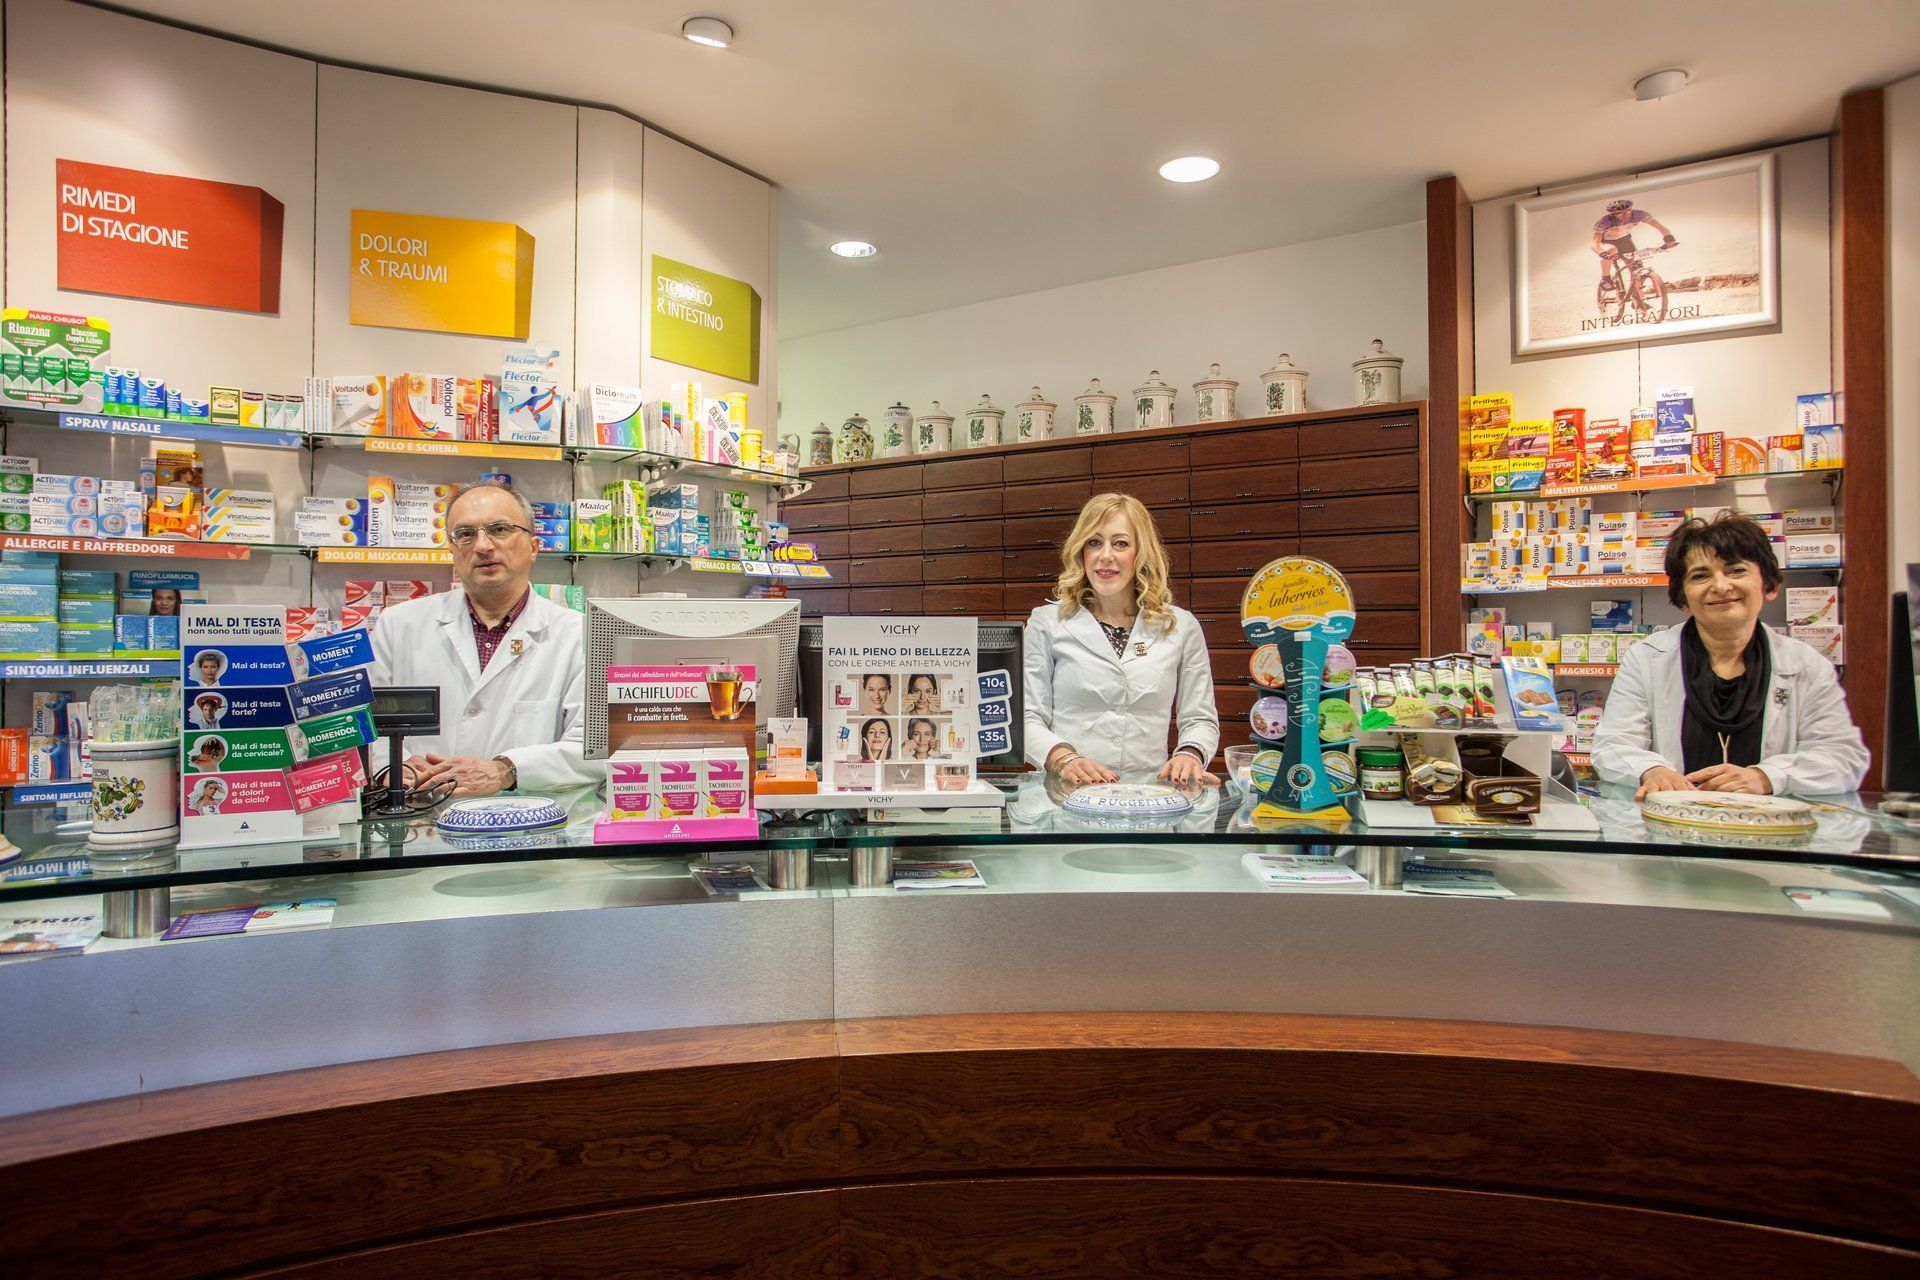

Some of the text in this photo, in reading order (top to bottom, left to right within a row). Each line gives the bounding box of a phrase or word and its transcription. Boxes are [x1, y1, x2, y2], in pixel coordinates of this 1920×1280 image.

[62, 184, 136, 215] RIMEDI
[62, 212, 189, 250] DI STAGIONE
[360, 233, 428, 256] DOLORI
[359, 258, 448, 283] & TRAUMI
[657, 276, 713, 307] STOMACO
[29, 313, 87, 325] NASO CHIUSO?
[657, 298, 724, 331] & INTESTINO
[1581, 304, 1701, 331] INTEGRATORI
[8, 322, 51, 337] Rinazina
[505, 354, 537, 365] Flector
[504, 370, 541, 383] Flector
[335, 385, 365, 394] Voltadol
[595, 387, 637, 400] Dicloreum
[444, 377, 454, 417] Voltadol
[65, 416, 161, 434] SPRAY NASALE
[1511, 425, 1544, 433] Friliver
[511, 432, 540, 442] Flector
[371, 440, 458, 454] COLLO E SCHIENA
[1713, 433, 1722, 469] SUSTENIUM
[397, 483, 429, 493] Voltaren
[1545, 484, 1617, 496] MULTIVITAMINICI
[228, 495, 272, 503] VEGETALLUMINA
[305, 497, 334, 506] Voltaren
[395, 499, 428, 508] Voltaren
[580, 502, 609, 511] Maalox
[298, 513, 327, 521] Voltaren
[394, 515, 428, 524] Voltaren
[655, 510, 677, 519] Maalox
[1599, 521, 1627, 529] Polase
[1786, 516, 1816, 524] Polase
[370, 507, 379, 546] Voltaren
[302, 531, 331, 539] Voltaren
[392, 530, 426, 539] Voltaren
[4, 538, 175, 554] ALLERGIE E RAFFREDDORE
[324, 551, 437, 562] DOLORI MUSCOLARI E
[695, 560, 731, 570] STOMACO E
[132, 572, 196, 580] RINOFLUIMUCIL
[1606, 577, 1649, 586] POTASSIO
[188, 618, 281, 627] I MAL DI TESTA
[652, 611, 750, 626] SAMSUNG
[233, 627, 251, 635] tutti
[253, 628, 282, 637] uguali.
[880, 625, 920, 635] VICHY
[312, 646, 355, 663] MOMENT
[828, 648, 971, 656] FAI IL PIENO DI BELLEZZA
[899, 658, 941, 667] ANTI-ETÀ
[6, 664, 150, 675] SINTOMI INFLUENZALI
[981, 678, 1005, 688] -10€
[302, 684, 361, 705] MOMENTACT
[617, 686, 698, 699] TACHIFLUDEC
[981, 705, 1005, 715] -22€
[671, 713, 689, 721] fretta.
[308, 726, 358, 744] MOMENDOL
[980, 732, 1005, 742] -35€
[244, 749, 284, 757] cervicale?
[295, 777, 341, 795] MOMENTACT
[21, 793, 57, 801] SINTOMI
[239, 788, 264, 796] dolori
[244, 796, 270, 804] ciclo?
